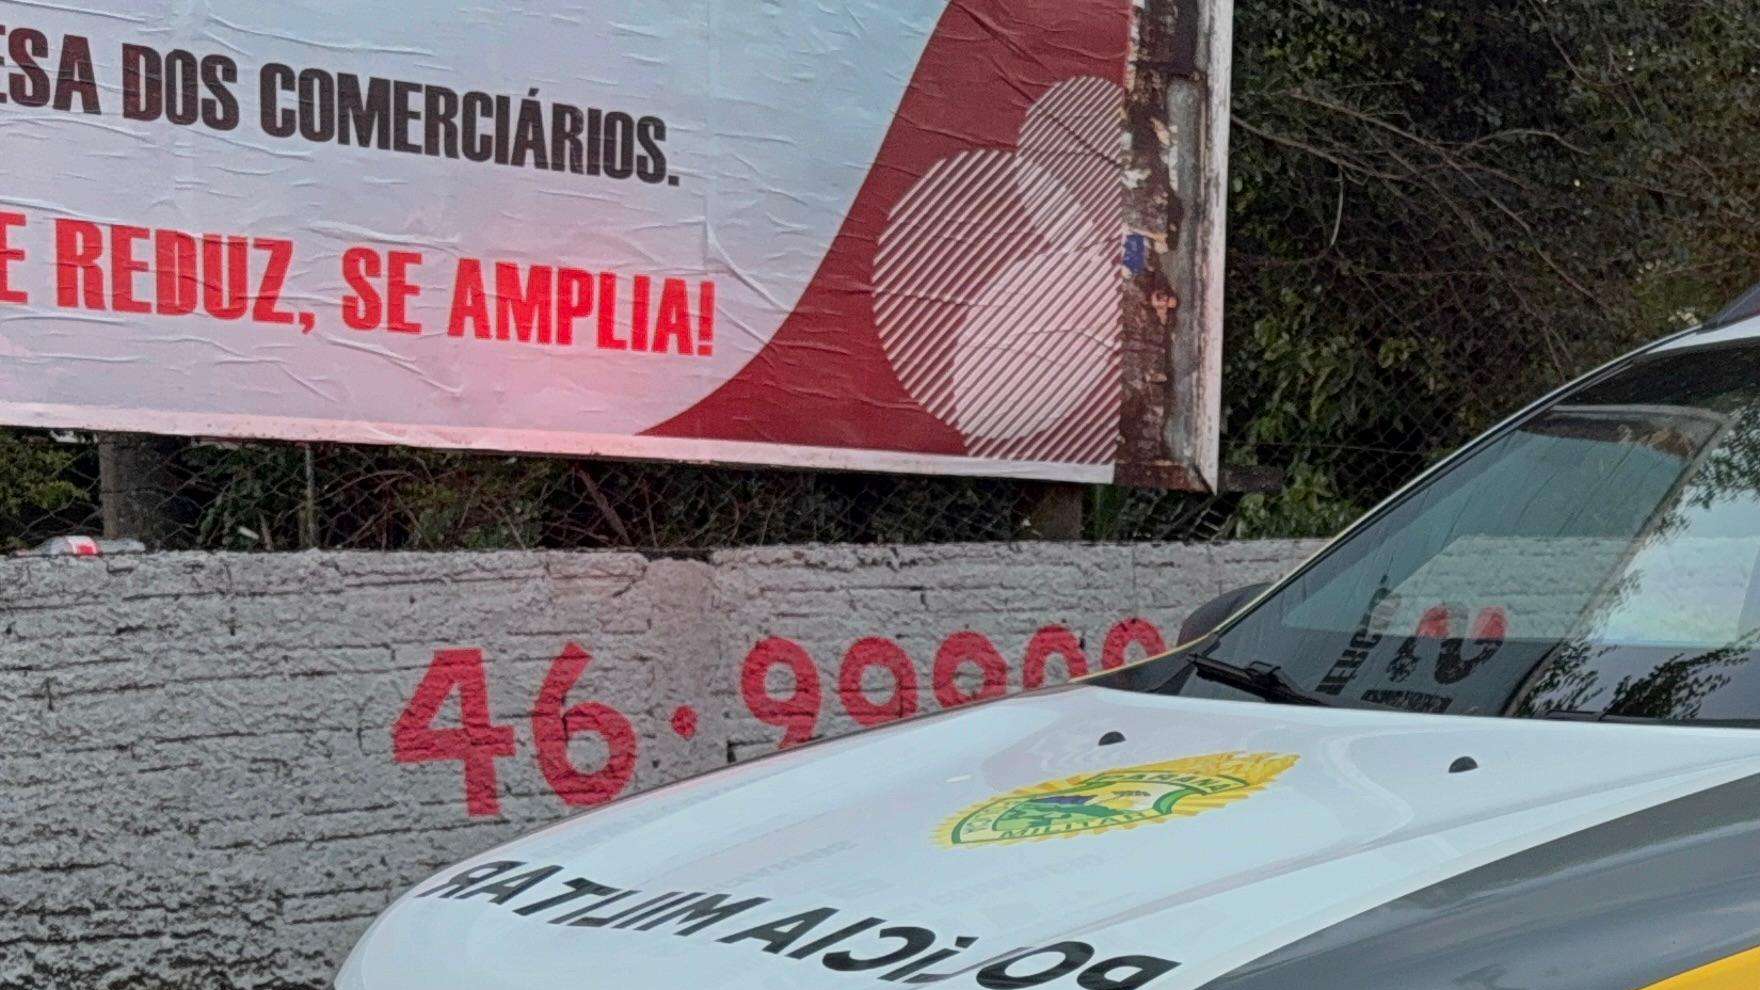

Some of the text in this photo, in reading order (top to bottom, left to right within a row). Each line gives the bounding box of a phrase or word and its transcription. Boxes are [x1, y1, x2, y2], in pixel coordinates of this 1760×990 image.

[0, 25, 680, 187] SA DOS COMERCIÁRIOS.
[55, 217, 315, 335] REDUZ,
[341, 246, 422, 334] SE
[447, 258, 716, 357] AMPLIA!
